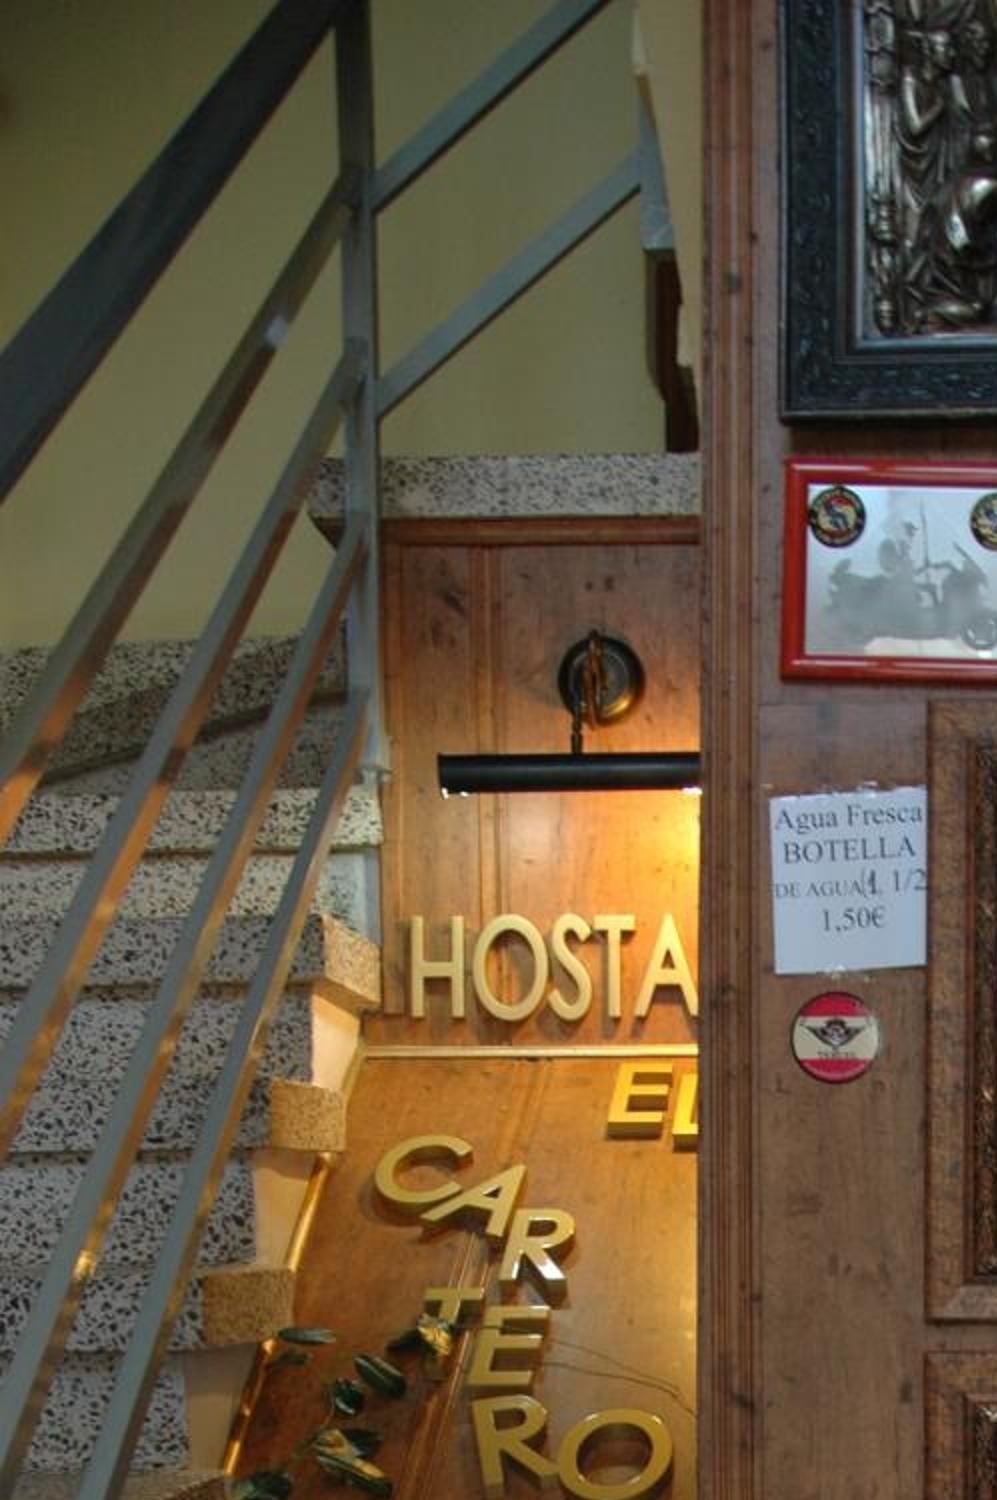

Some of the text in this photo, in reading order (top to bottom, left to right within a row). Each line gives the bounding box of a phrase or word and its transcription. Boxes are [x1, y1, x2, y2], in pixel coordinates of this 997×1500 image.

[775, 803, 923, 834] Agua Fresca
[784, 836, 916, 864] BOTELLA
[776, 883, 800, 898] DE
[822, 906, 887, 932] 1,50€
[411, 913, 698, 1022] HOSTA
